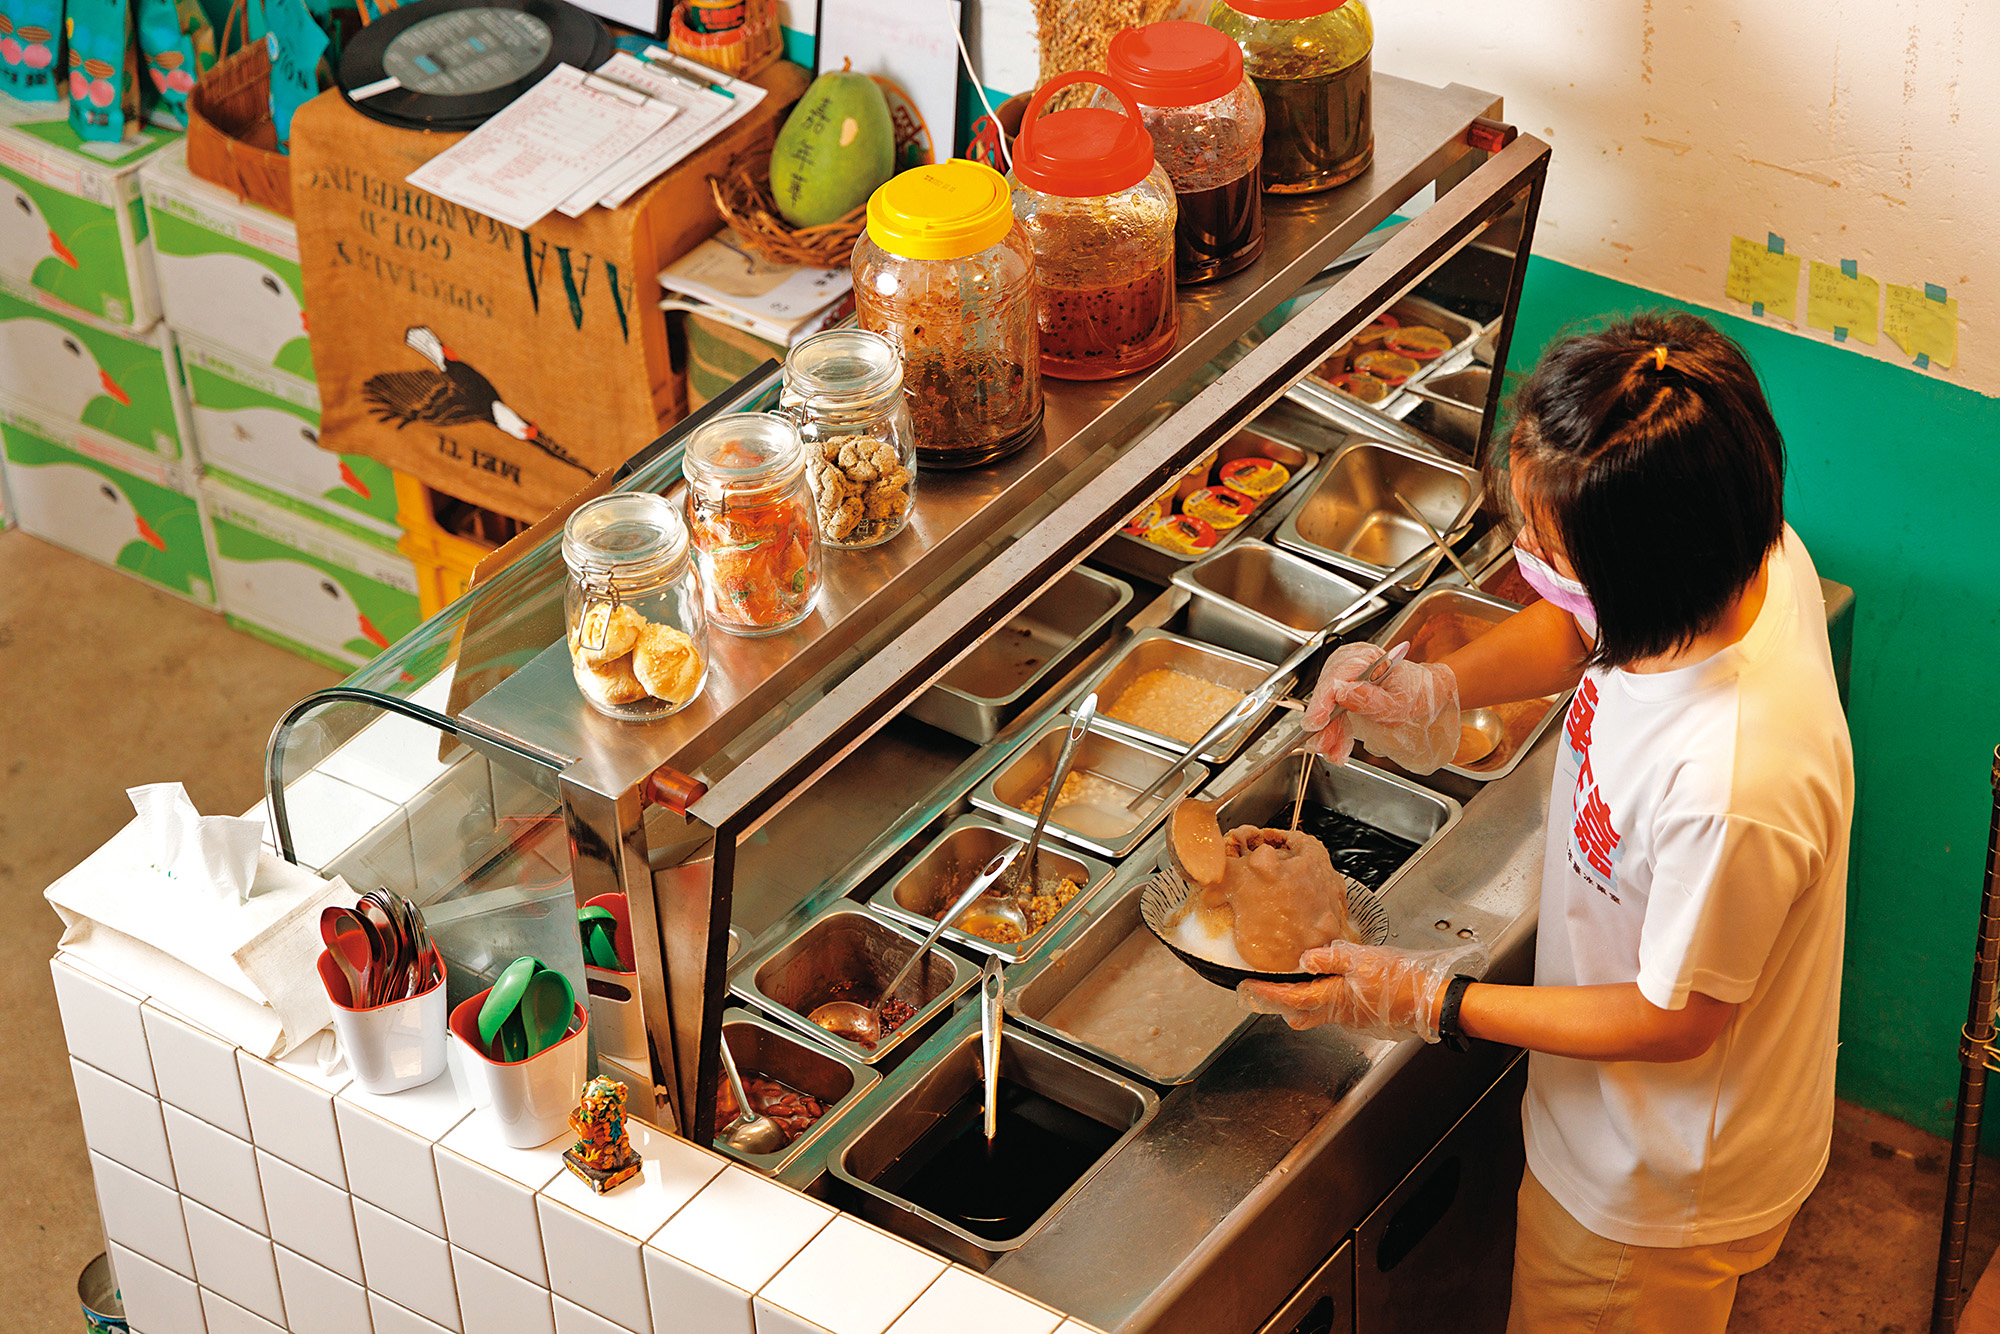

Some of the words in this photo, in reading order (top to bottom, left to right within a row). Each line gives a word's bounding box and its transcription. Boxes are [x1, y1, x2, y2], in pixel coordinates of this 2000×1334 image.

[787, 97, 832, 208] 嘉年華
[359, 207, 452, 263] GOLD
[469, 448, 523, 487] MEI
